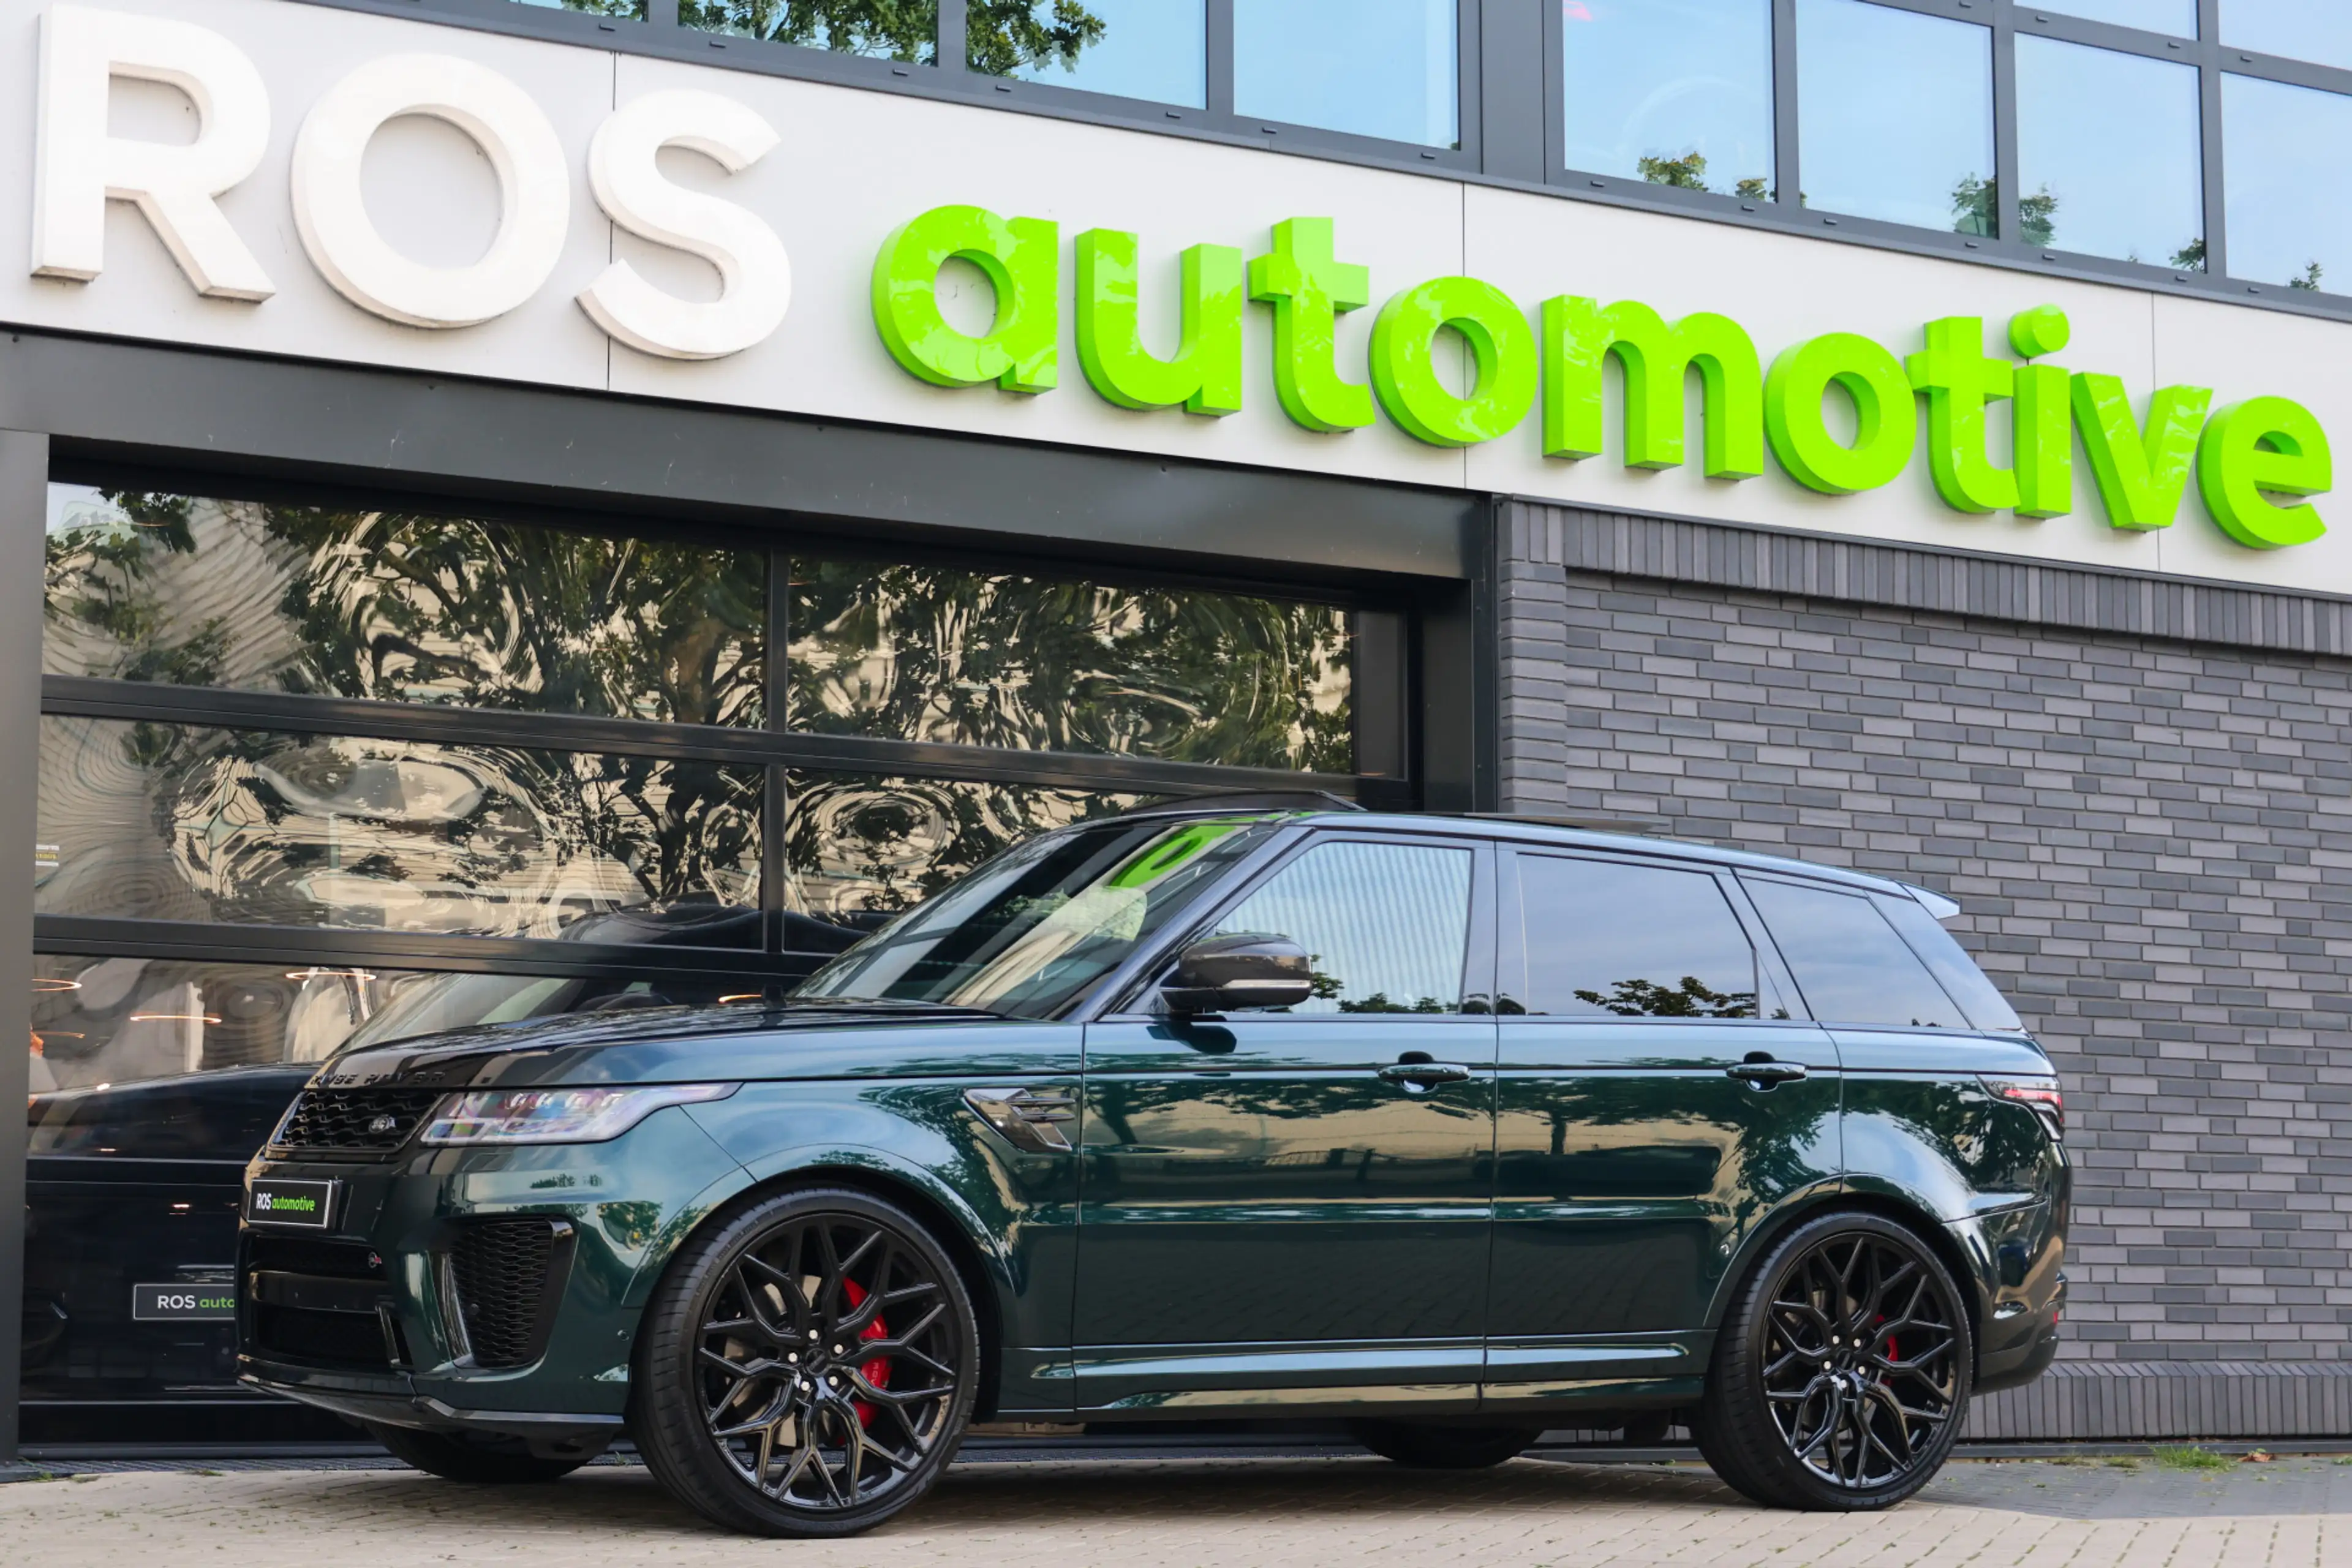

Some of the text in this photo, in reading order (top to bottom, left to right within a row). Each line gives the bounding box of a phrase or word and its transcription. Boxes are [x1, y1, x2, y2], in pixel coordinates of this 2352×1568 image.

[32, 2, 2332, 549] ROS automotive
[256, 1193, 315, 1212] ROS automotive
[157, 1295, 196, 1309] ROS
